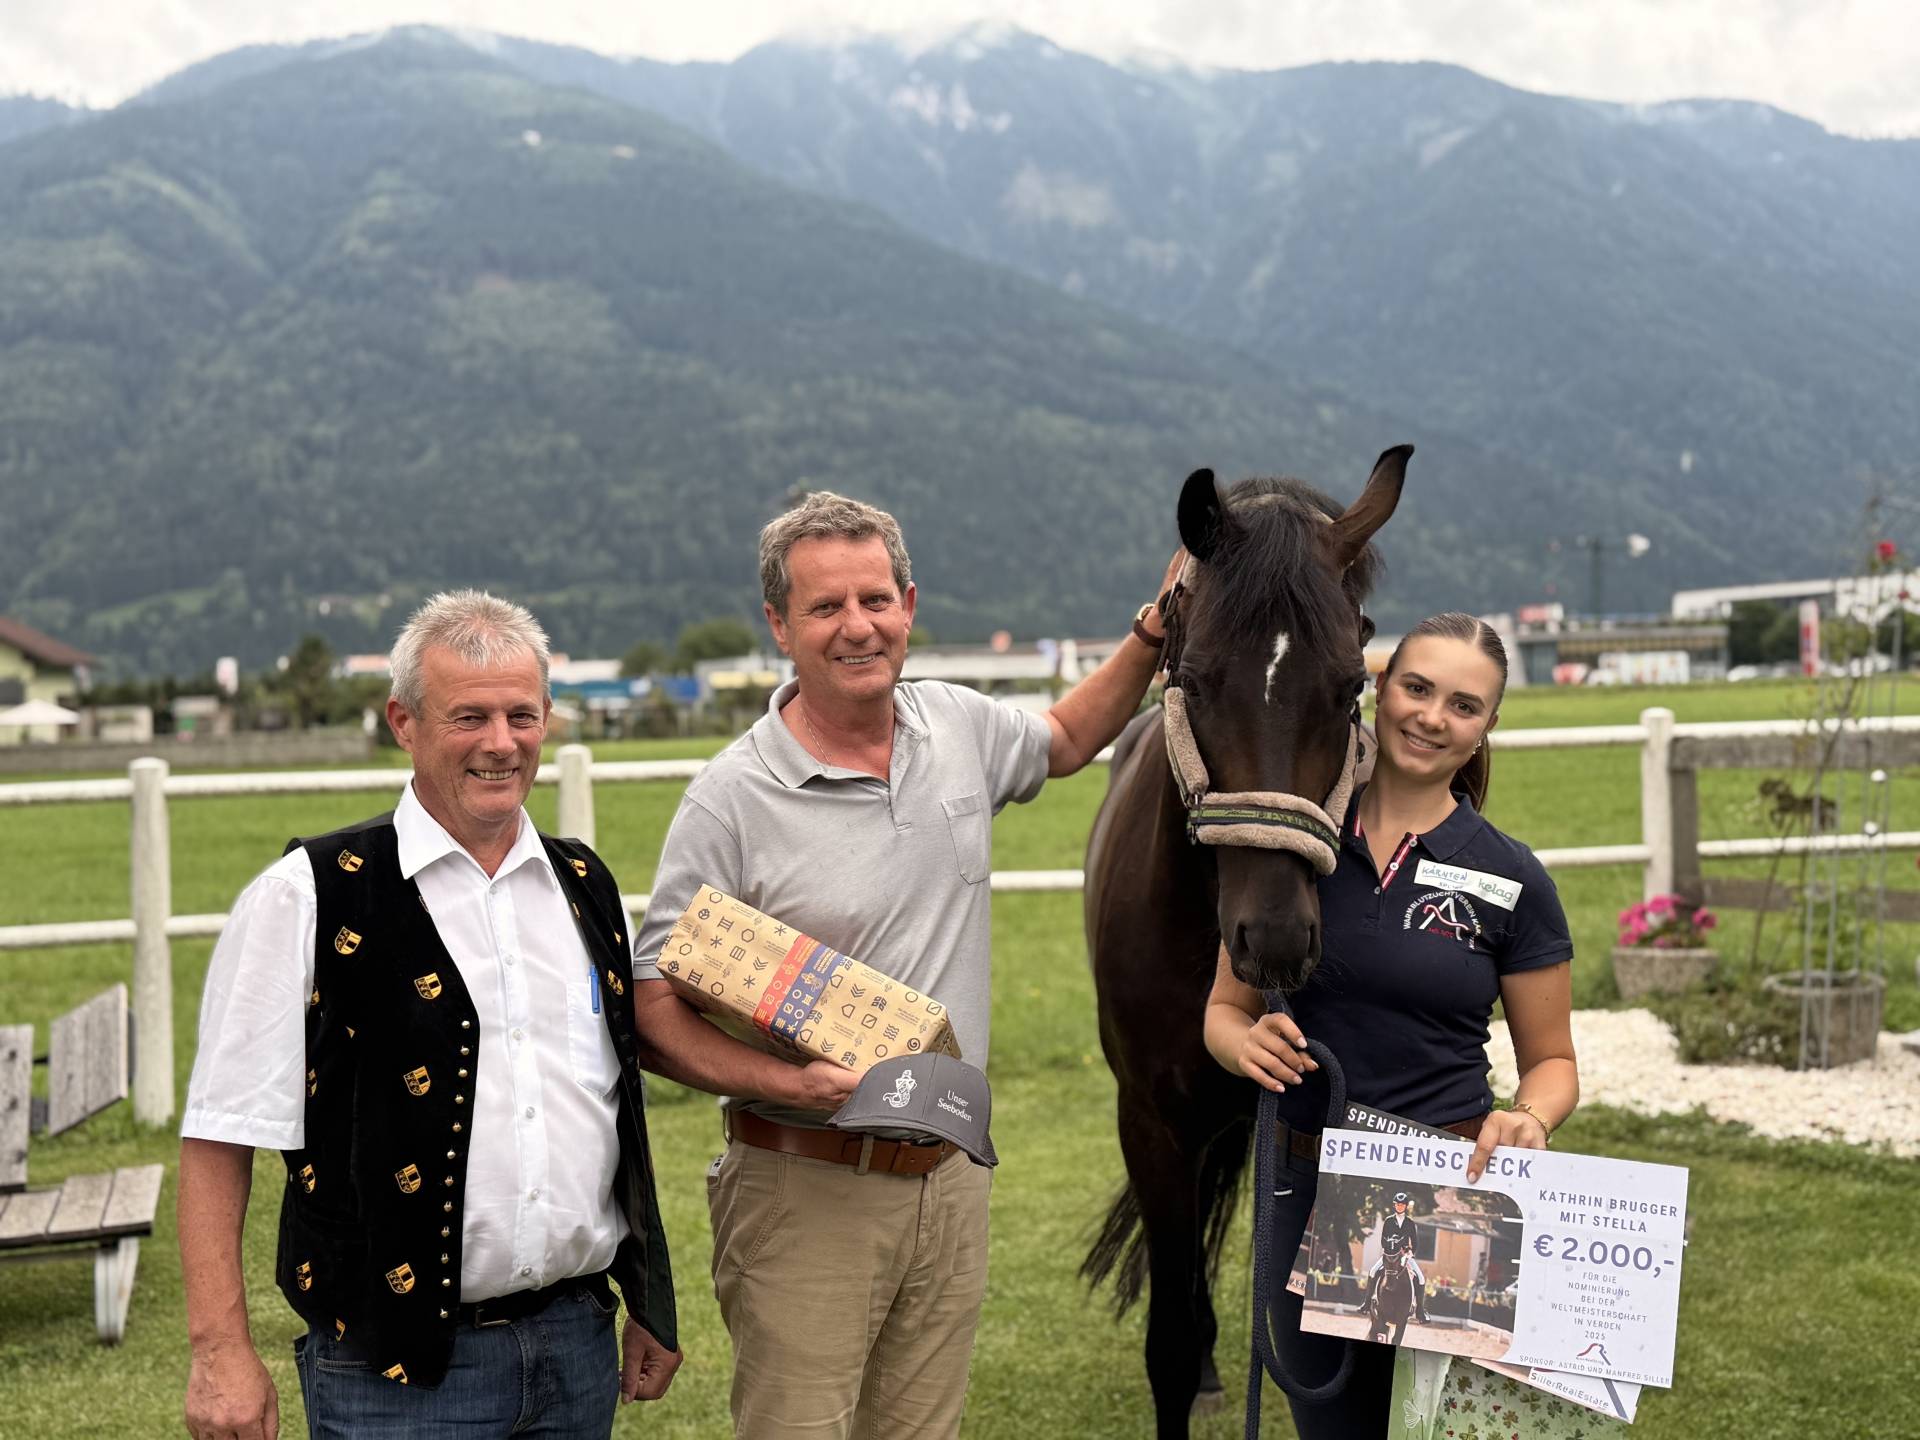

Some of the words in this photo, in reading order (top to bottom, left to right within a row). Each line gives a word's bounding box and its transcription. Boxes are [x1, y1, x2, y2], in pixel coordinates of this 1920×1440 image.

[1479, 878, 1513, 902] kelag
[1403, 891, 1476, 929] WARMBLUTZUCHTVEREIN
[947, 1089, 969, 1107] Unser
[937, 1097, 972, 1124] Seeboden
[1325, 1138, 1533, 1179] SPENDENSCECK
[1539, 1189, 1603, 1208] KATHRIN
[1609, 1198, 1678, 1217] BRUGGER
[1560, 1211, 1586, 1225] MIT
[1592, 1215, 1647, 1233] STELLA
[1561, 1237, 1675, 1278] 2.000,-
[1568, 1281, 1631, 1297] NOMINIERUNG
[1602, 1274, 1617, 1284] DIE
[1581, 1295, 1595, 1304] BEI
[1598, 1297, 1615, 1307] DER
[1551, 1302, 1648, 1323] WELTMEISTERSCHAFT
[1574, 1317, 1583, 1326] IN
[1587, 1319, 1622, 1331] VERDEN
[1584, 1330, 1606, 1341] 2025
[1558, 1361, 1585, 1371] ASTRID
[1587, 1366, 1603, 1375] UND
[1530, 1372, 1610, 1409] SillerRealEstate
